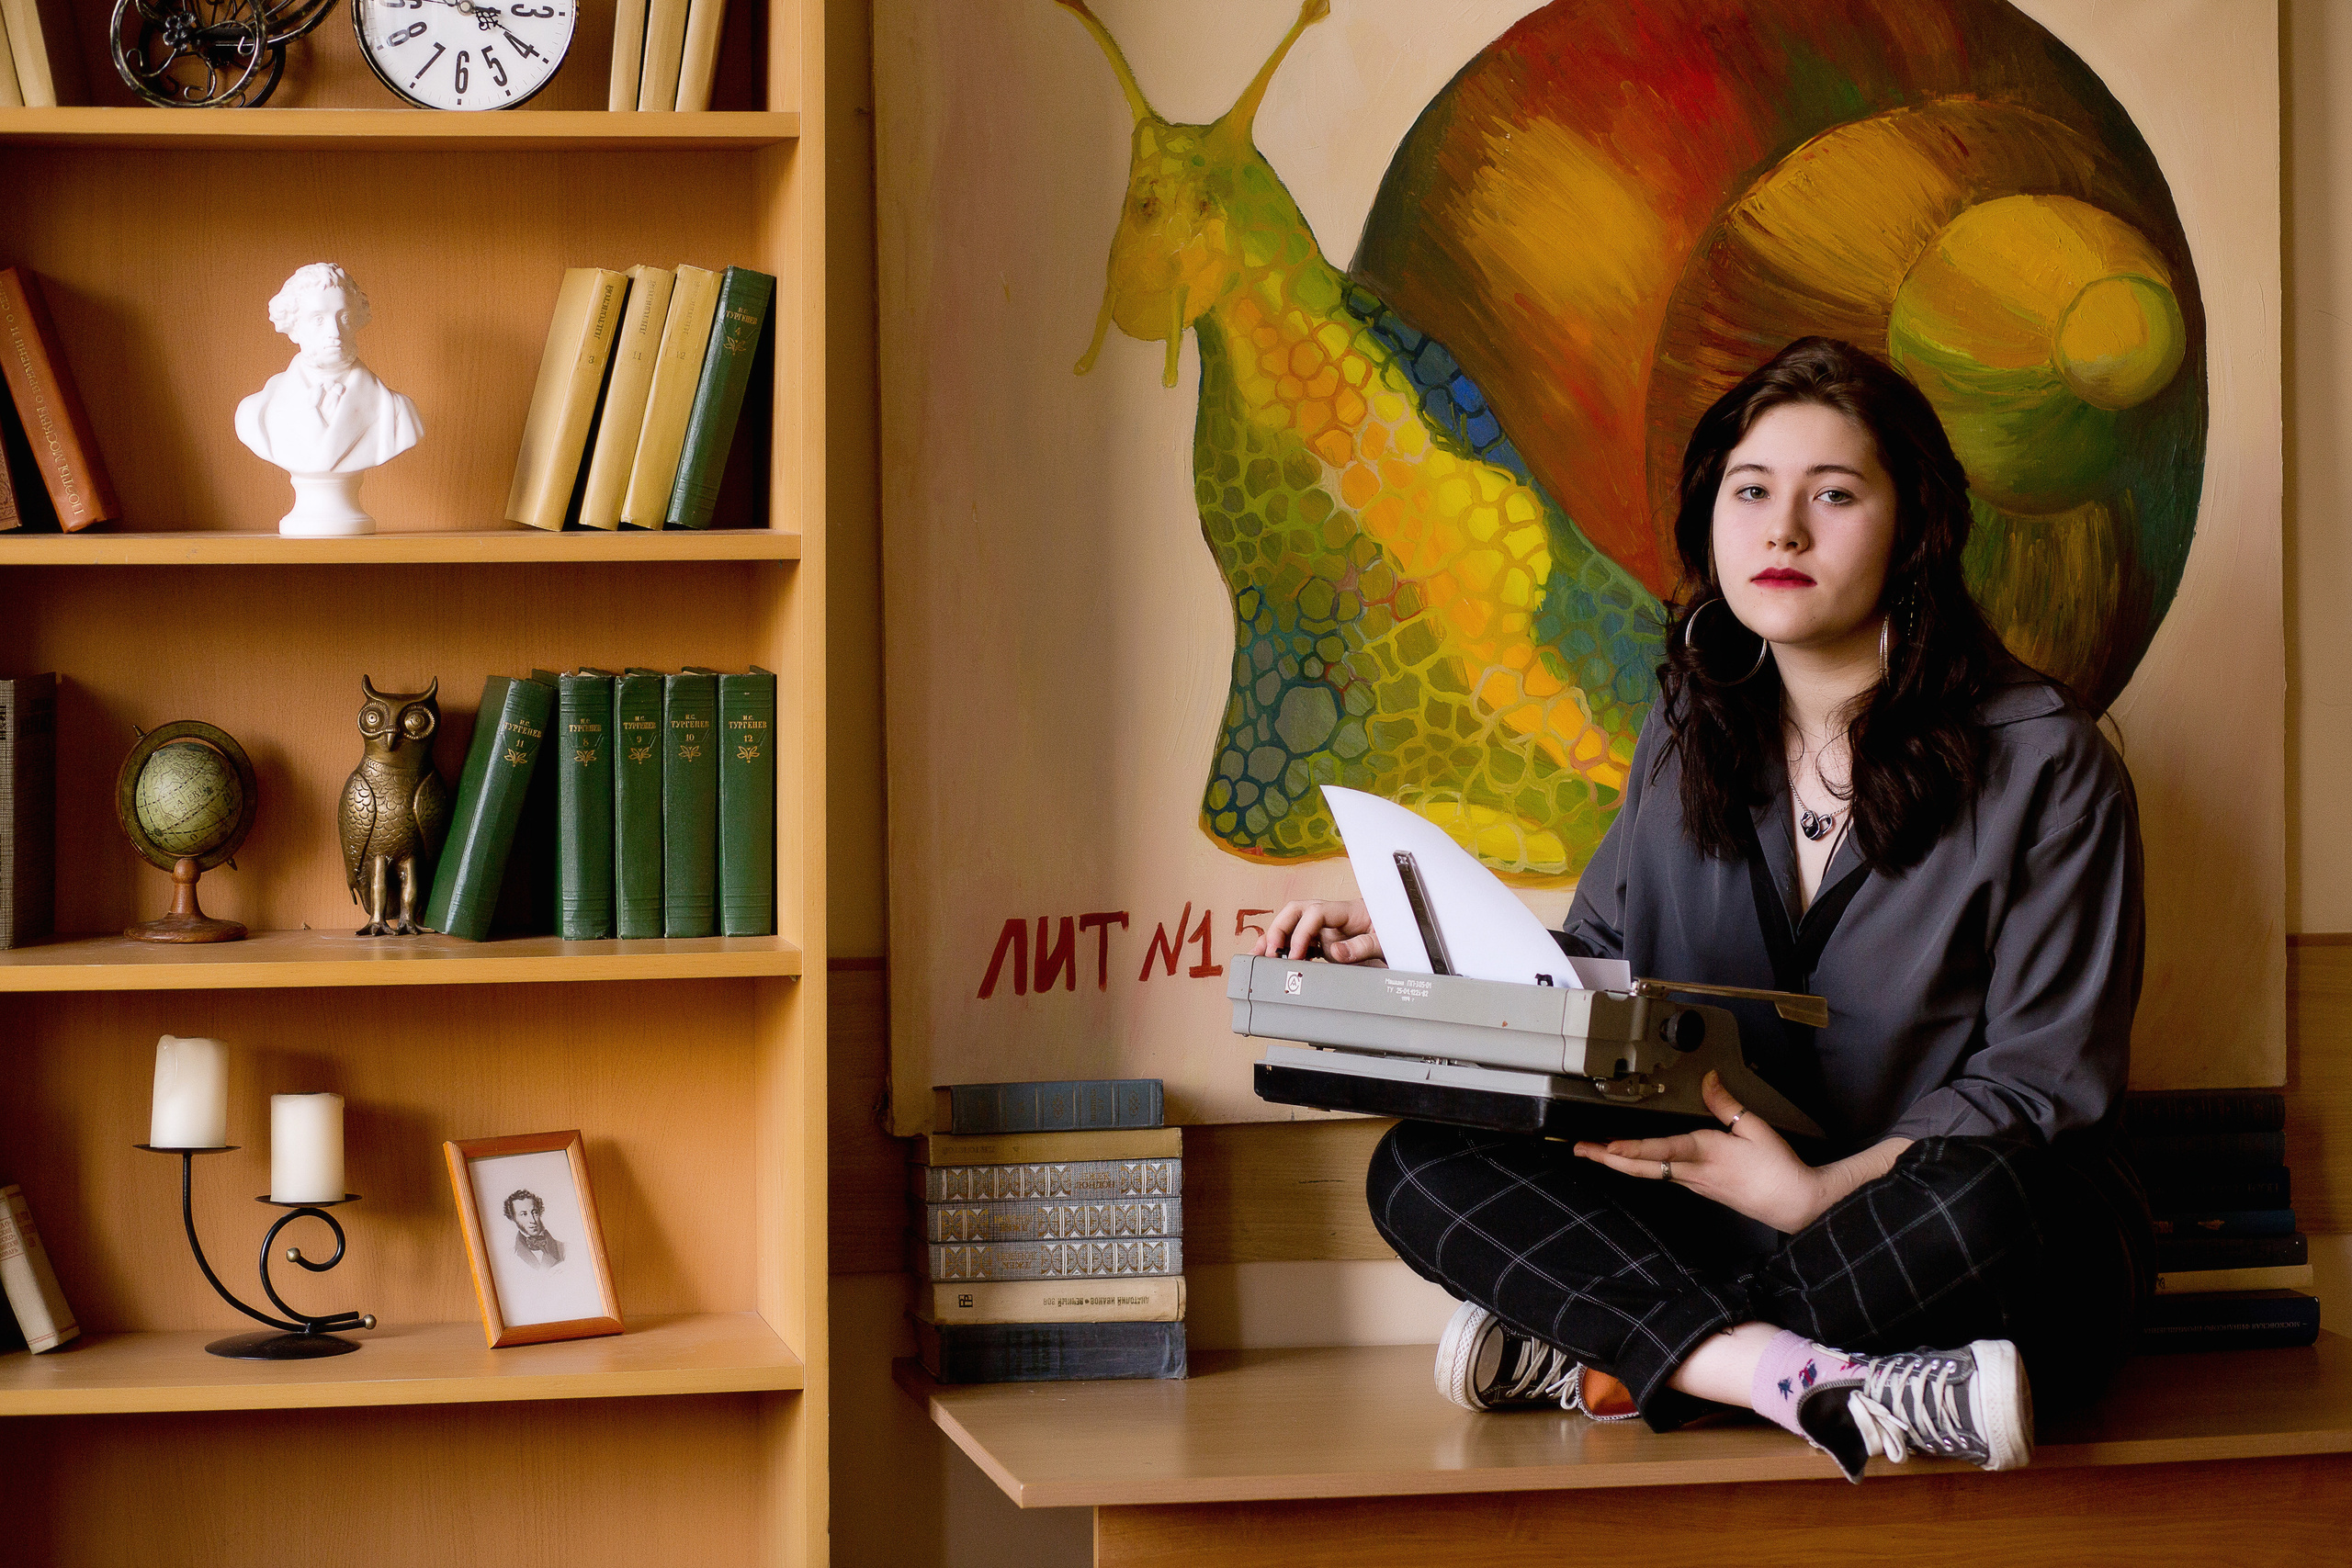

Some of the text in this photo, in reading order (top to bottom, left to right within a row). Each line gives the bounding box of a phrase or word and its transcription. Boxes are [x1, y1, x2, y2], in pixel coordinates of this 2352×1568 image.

[510, 4, 554, 19] 3
[386, 20, 427, 47] 8
[503, 30, 539, 59] 4
[414, 41, 447, 80] 7
[481, 44, 508, 87] 5
[455, 50, 469, 94] 6
[726, 310, 758, 325] ТУРГЕНЕВ
[734, 326, 741, 336] 4
[632, 350, 642, 361] 11
[676, 351, 686, 360] 12
[14, 338, 41, 394] ВРЕМЕНИ
[36, 405, 66, 463] МОСКВЫ
[58, 463, 85, 516] ПОЭТЫ
[568, 724, 602, 732] ТУРГЕНЕВ
[623, 721, 656, 730] ТУРГЕНЕВ
[670, 720, 710, 728] ТУРГЕНЕВ
[728, 720, 767, 729] ТУРГЕНЕВ
[503, 722, 542, 739] ТУРГЕНЕВ
[582, 738, 589, 747] 8
[636, 735, 642, 743] 9
[685, 734, 695, 742] 10
[743, 734, 753, 742] 12
[515, 739, 525, 749] 11
[976, 910, 1129, 1000] ЛИТ
[1057, 1297, 1083, 1307] ВЕЧНЫЙ
[1091, 1297, 1114, 1305] ИВАНОВ
[1117, 1296, 1149, 1306] АНАТОЛИЙ
[2252, 1322, 2301, 1331] МОСКОВСКАЯ
